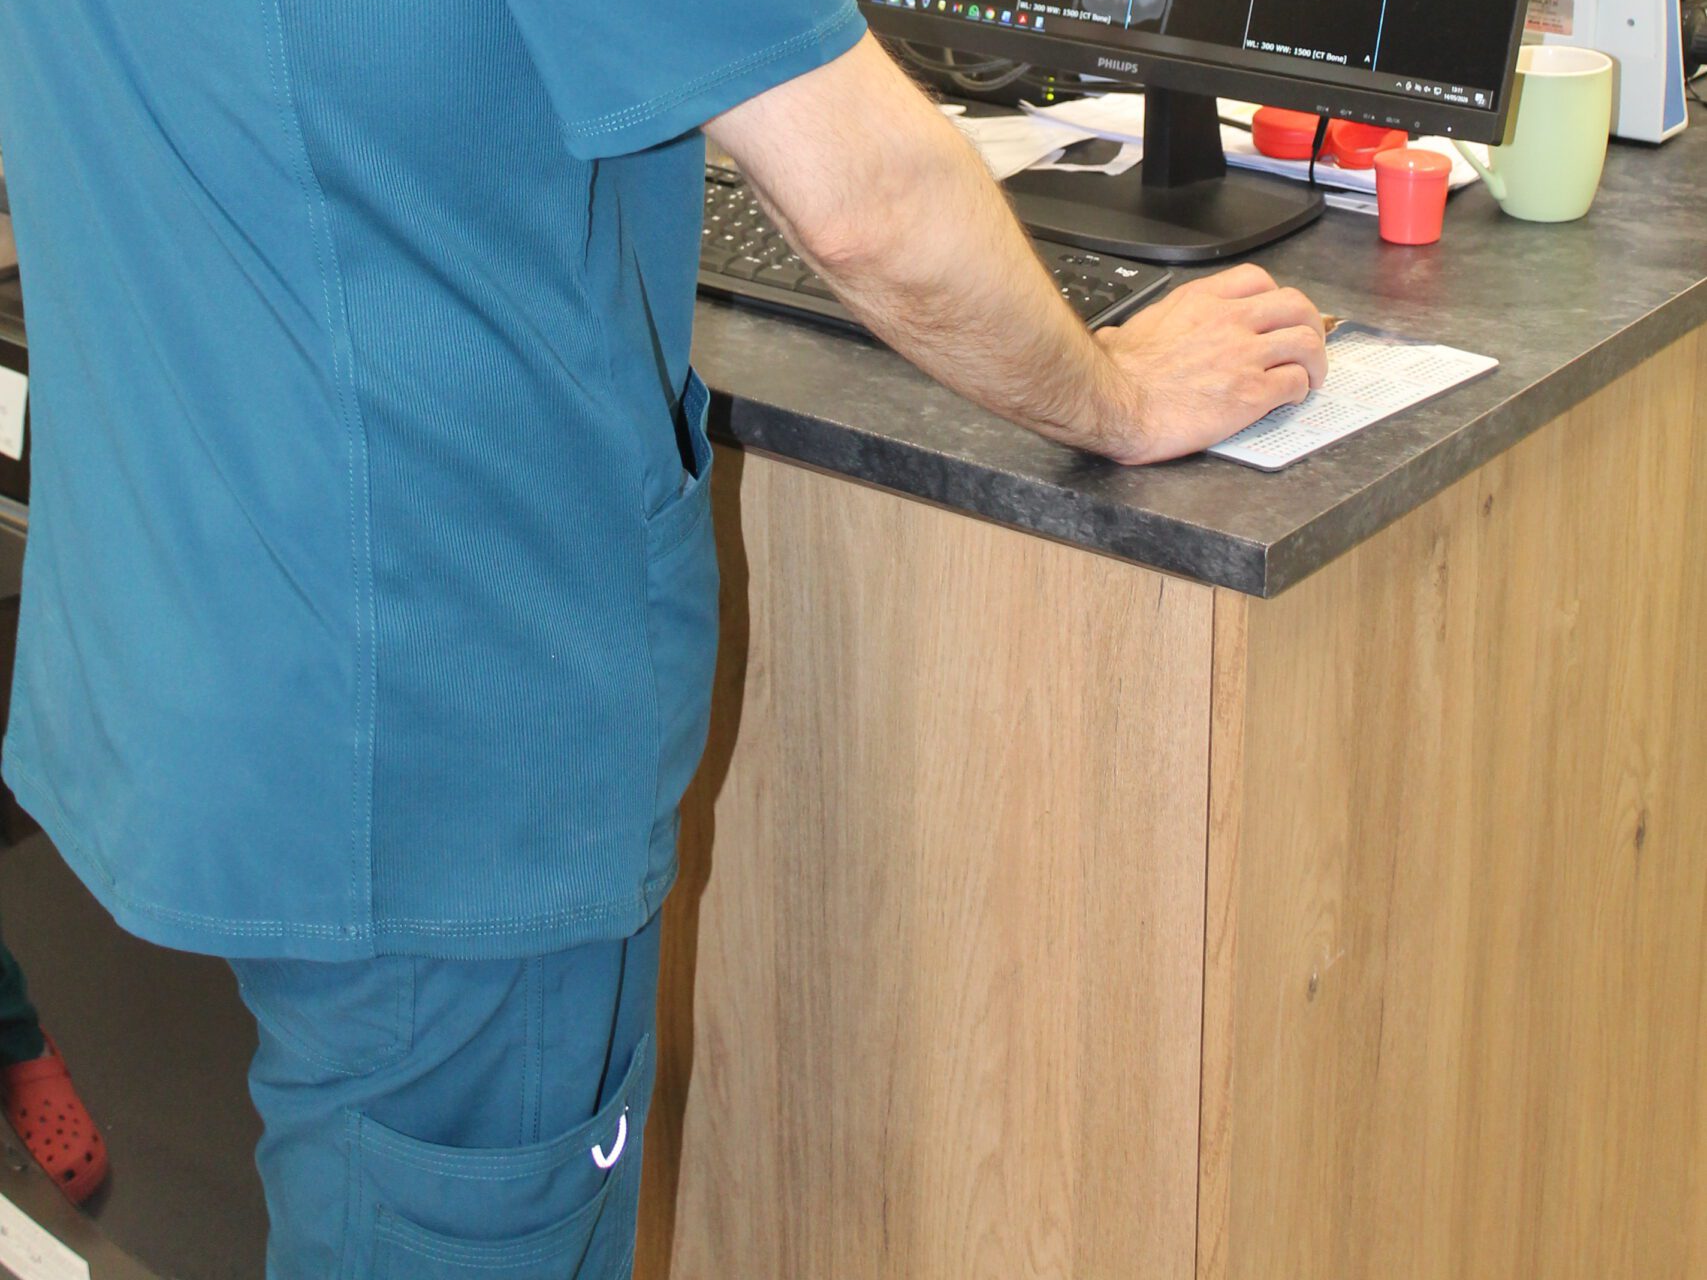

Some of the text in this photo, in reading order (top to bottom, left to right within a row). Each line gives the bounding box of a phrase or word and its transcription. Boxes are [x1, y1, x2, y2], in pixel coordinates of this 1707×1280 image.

[1246, 39, 1347, 65] WL: 300 WW: 1500 [CT Bone]
[1364, 55, 1370, 63] A
[1097, 57, 1138, 73] PHILIPS
